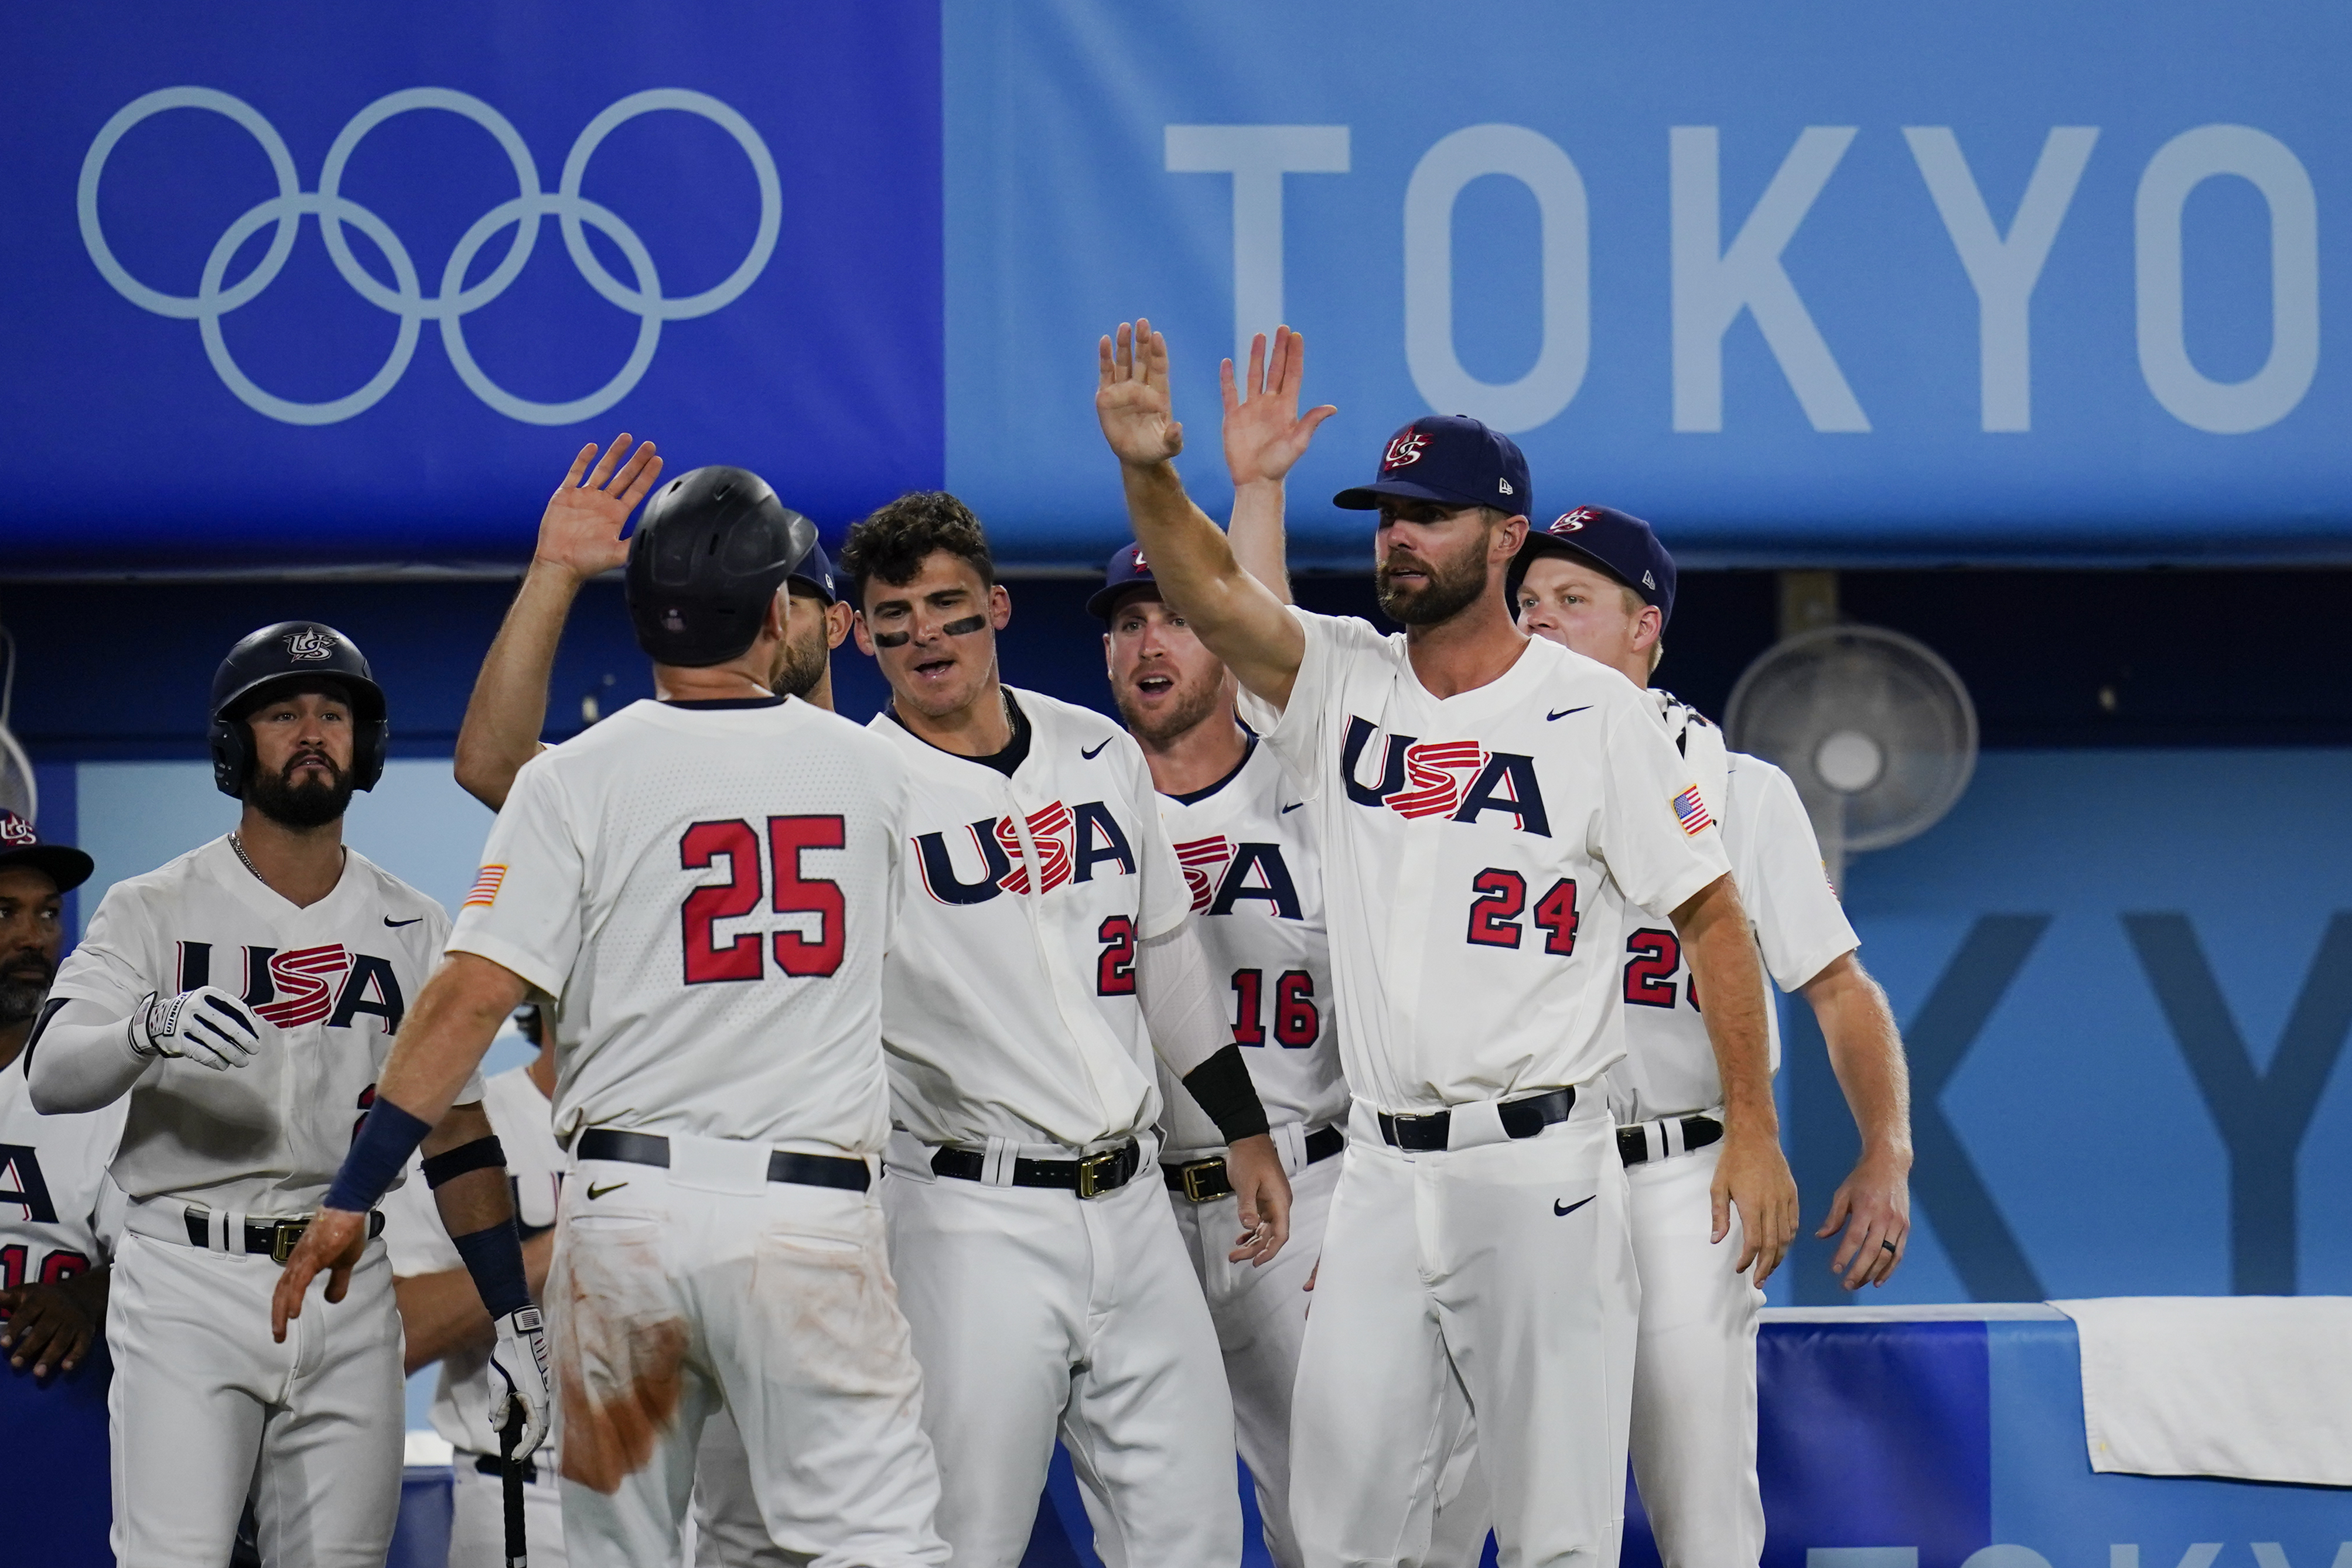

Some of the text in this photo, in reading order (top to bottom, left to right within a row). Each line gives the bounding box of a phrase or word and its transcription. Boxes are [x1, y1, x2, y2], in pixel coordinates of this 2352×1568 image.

[1165, 123, 2320, 435] TOKYO
[1341, 713, 1552, 838] USA
[679, 814, 845, 985] 25
[910, 800, 1136, 907] USA
[1097, 914, 1138, 996] 2
[1467, 867, 1580, 956] 24
[176, 940, 405, 1036] USA
[1231, 968, 1320, 1049] 16
[1623, 927, 1701, 1012] 2
